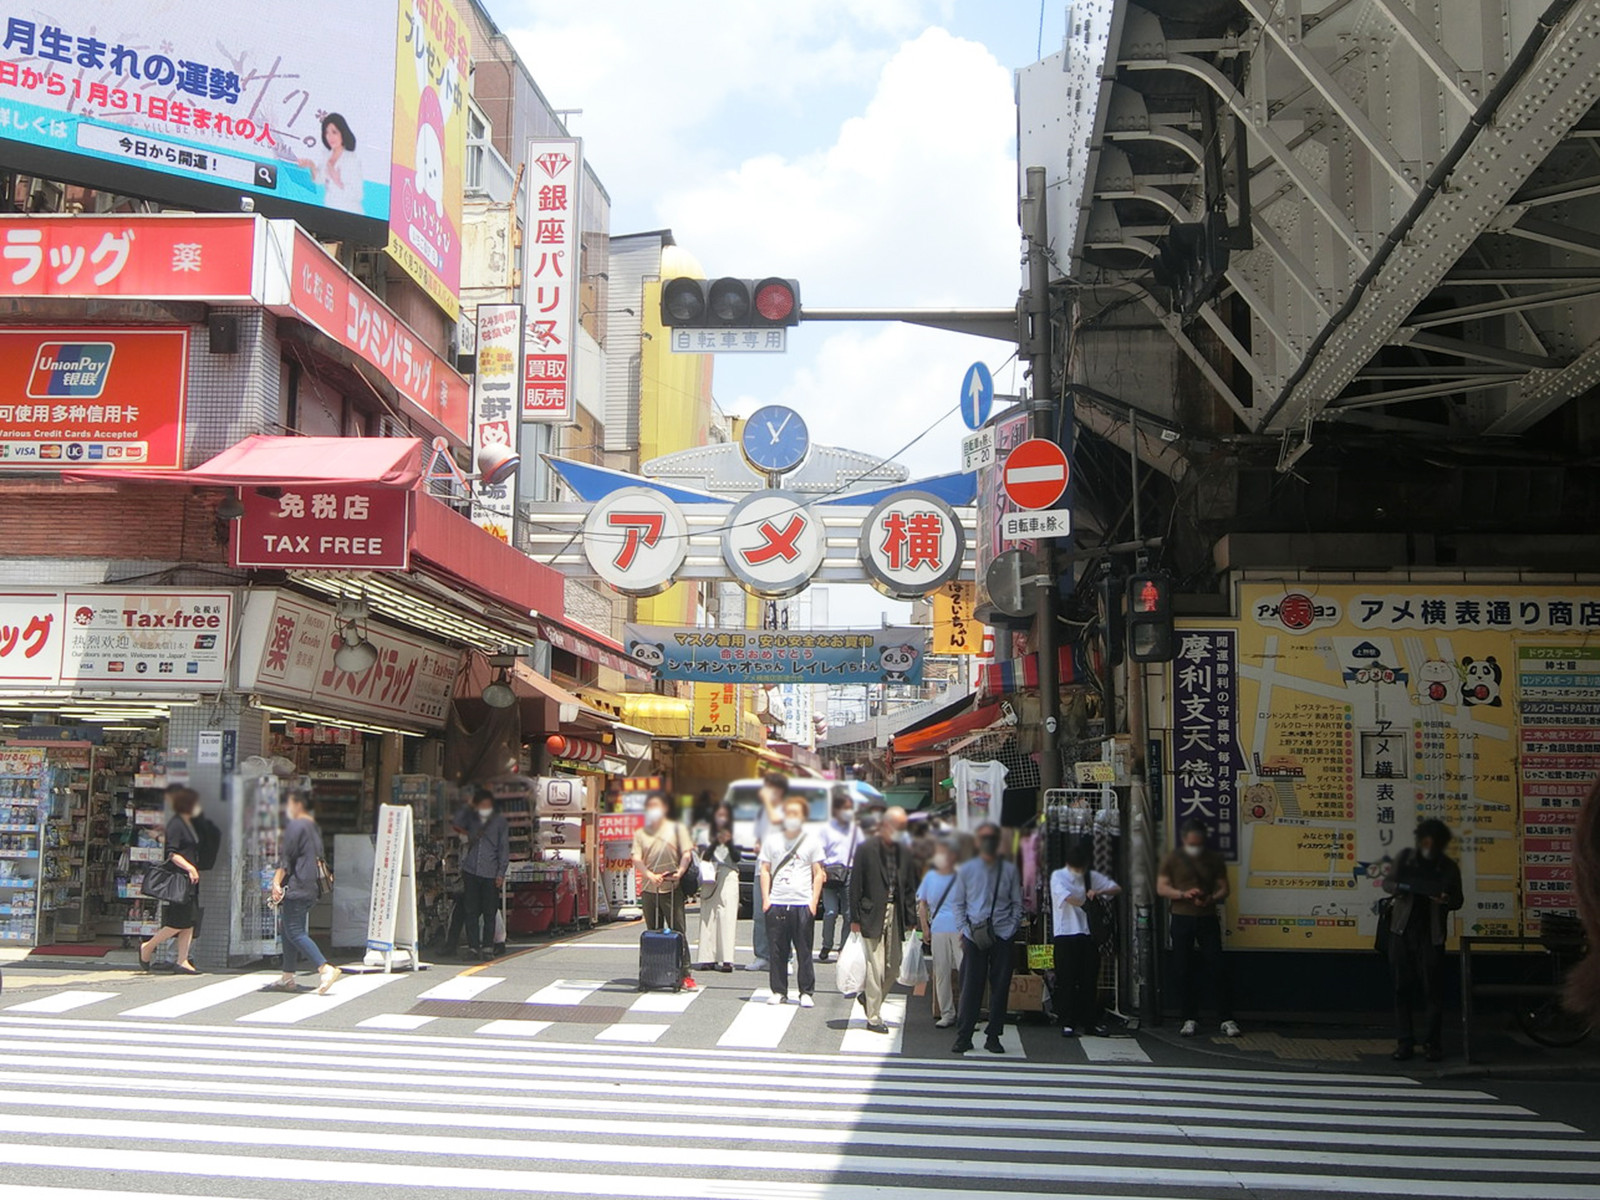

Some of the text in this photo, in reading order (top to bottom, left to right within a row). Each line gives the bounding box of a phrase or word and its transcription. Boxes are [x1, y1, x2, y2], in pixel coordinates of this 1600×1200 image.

[3, 17, 242, 104] 月生まれの運勢
[405, 9, 463, 115] プレゼント中
[4, 228, 135, 285] ラッグ
[172, 242, 203, 273] 薬
[534, 185, 568, 345] 銀座パリス
[303, 263, 334, 313] 化粧品
[347, 291, 432, 401] コクミンドラッグ
[677, 331, 782, 349] 自転車専用
[39, 357, 105, 376] UnionPay
[529, 358, 566, 378] 買取
[63, 372, 97, 386] 银联
[526, 388, 565, 408] 販売
[34, 429, 62, 438] Credit
[64, 429, 92, 438] Cards
[94, 430, 138, 440] Accepted
[963, 434, 992, 453] 自転車を除く
[14, 447, 36, 457] VISA
[278, 493, 370, 520] 免税店
[1007, 516, 1064, 534] 自転車を除く
[263, 535, 383, 555] TAX FREE
[607, 511, 944, 572] アメ横
[122, 610, 221, 629] Tax-free
[193, 605, 221, 614] 免税店
[266, 615, 295, 671] 薬
[673, 632, 875, 650] マスク着用・安心安全なお買物
[720, 649, 814, 660] 命名おめでとう
[1529, 648, 1591, 658] ドヴステーラー
[667, 660, 784, 676] シャオシャオちゃん
[709, 691, 721, 724] プラザ
[1375, 721, 1395, 846] アメ横表通り
[1538, 813, 1580, 821] カワチヤ
